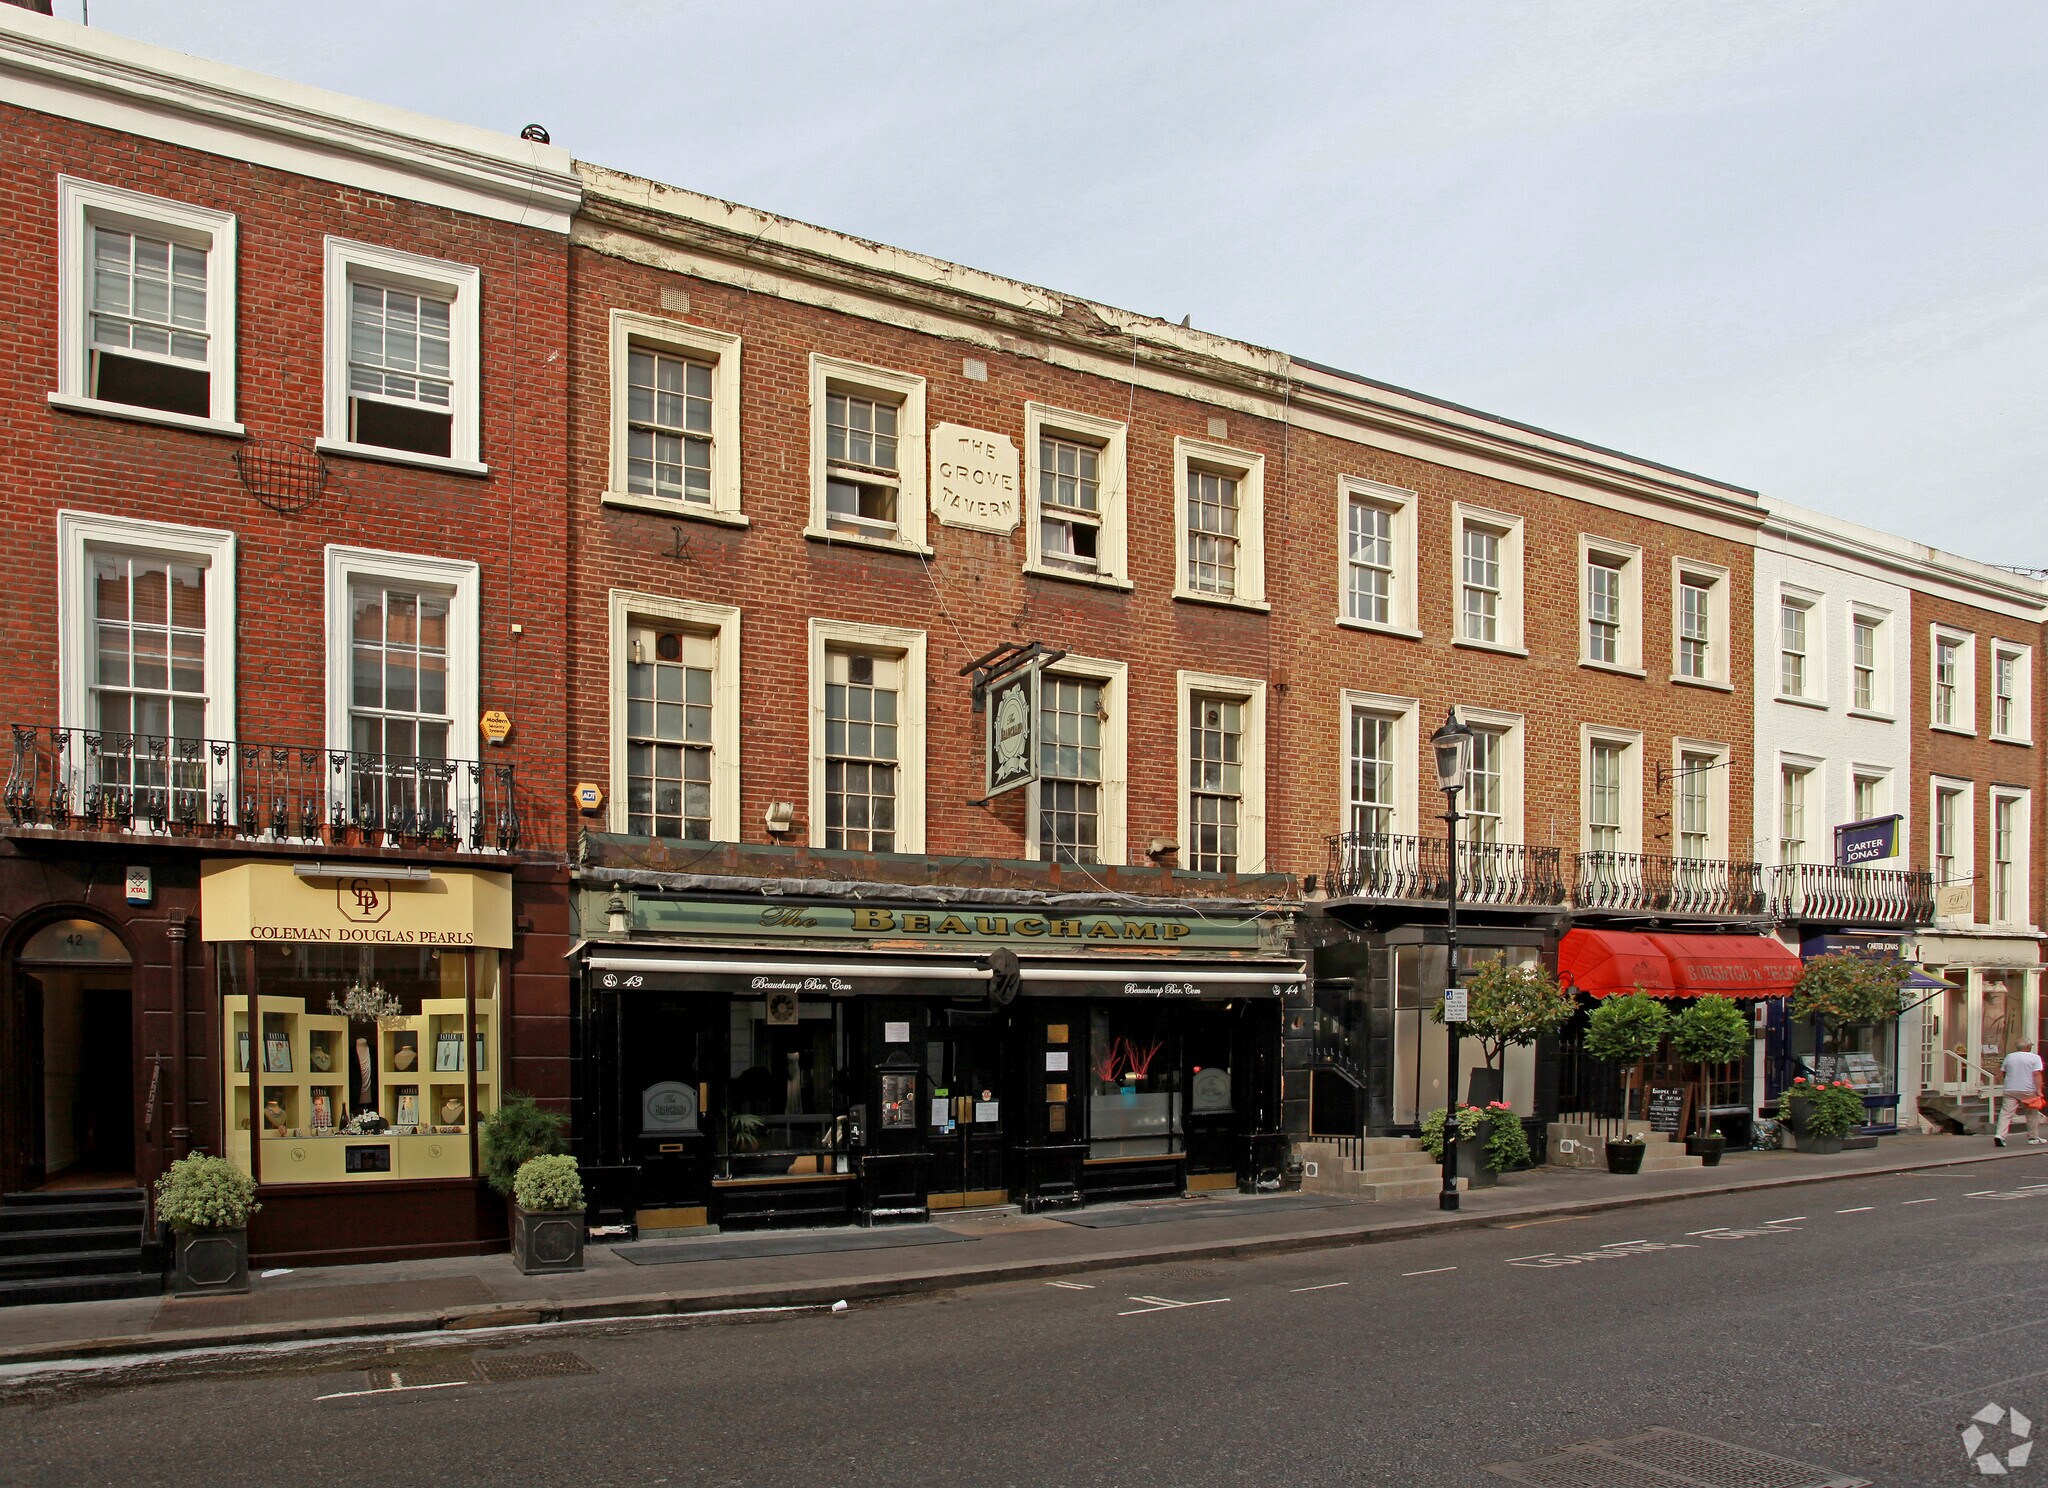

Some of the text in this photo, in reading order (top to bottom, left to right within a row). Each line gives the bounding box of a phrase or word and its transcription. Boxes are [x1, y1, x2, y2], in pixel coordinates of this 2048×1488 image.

[958, 438, 996, 459] THE
[940, 462, 1013, 491] GROVE
[943, 486, 1013, 517] TAVERN
[582, 791, 596, 800] ADT
[1847, 839, 1884, 852] CARTER
[1847, 848, 1879, 863] JONAS
[759, 905, 1191, 941] The BEAUCHAMP
[66, 934, 83, 946] 42
[250, 926, 474, 944] COLEMAN DOUGLAS PEARLS
[1867, 942, 1884, 950] CARTER
[1883, 943, 1899, 951] JONAS
[622, 975, 644, 987] 43
[751, 976, 803, 993] Beauchamp
[1124, 982, 1164, 997] Beauchamp
[1284, 984, 1299, 995] 44
[1510, 1224, 1803, 1268] LOADING ONLY
